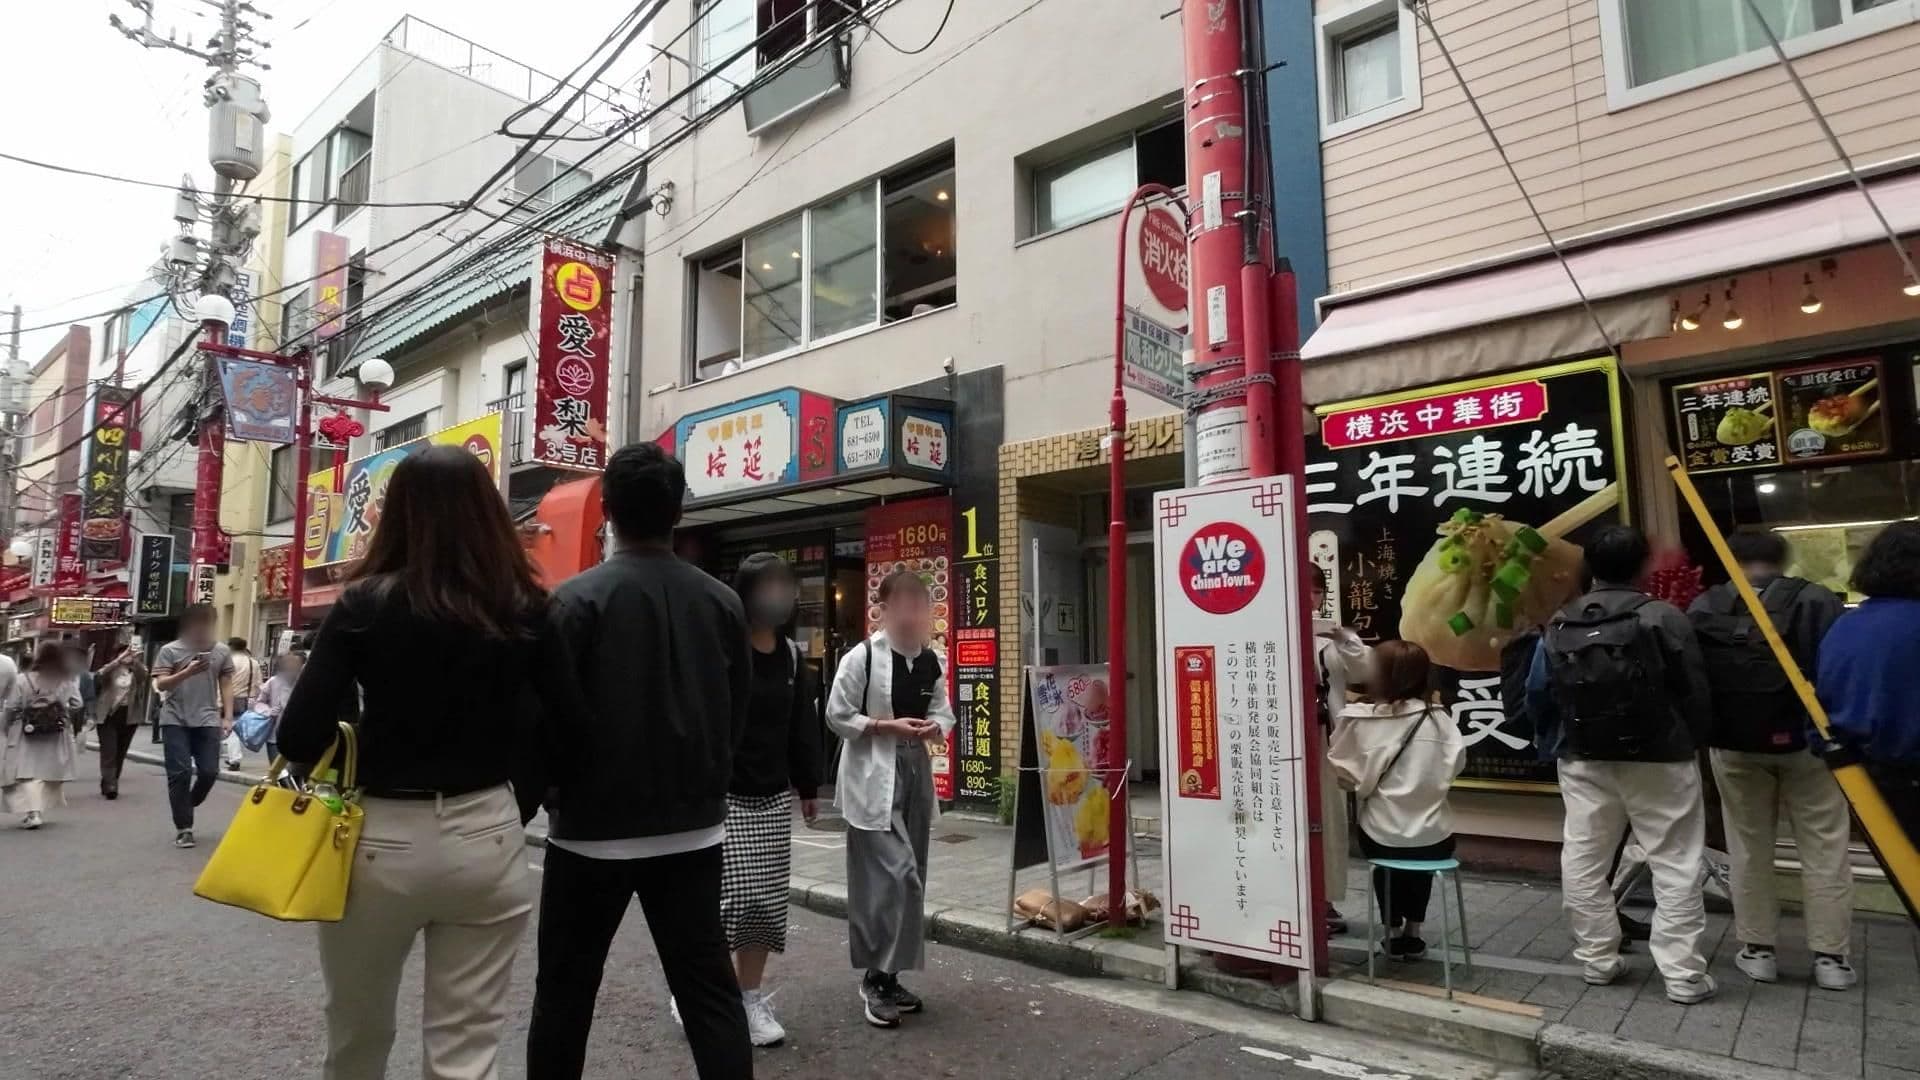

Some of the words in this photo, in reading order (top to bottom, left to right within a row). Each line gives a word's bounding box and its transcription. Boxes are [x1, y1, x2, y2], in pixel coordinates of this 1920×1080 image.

[565, 269, 595, 304] 占
[1346, 391, 1524, 441] 横浜中華街
[1680, 386, 1770, 413] 三年連続
[854, 415, 874, 430] TEL
[546, 441, 598, 466] 3号店
[1304, 422, 1608, 514] 三年連続
[961, 506, 995, 559] 1位
[1195, 534, 1247, 561] We
[1202, 558, 1241, 575] are
[1375, 527, 1398, 601] 上海焼き
[973, 563, 989, 626] 食べログ
[1190, 573, 1221, 591] China
[974, 682, 991, 758] 食べ放題
